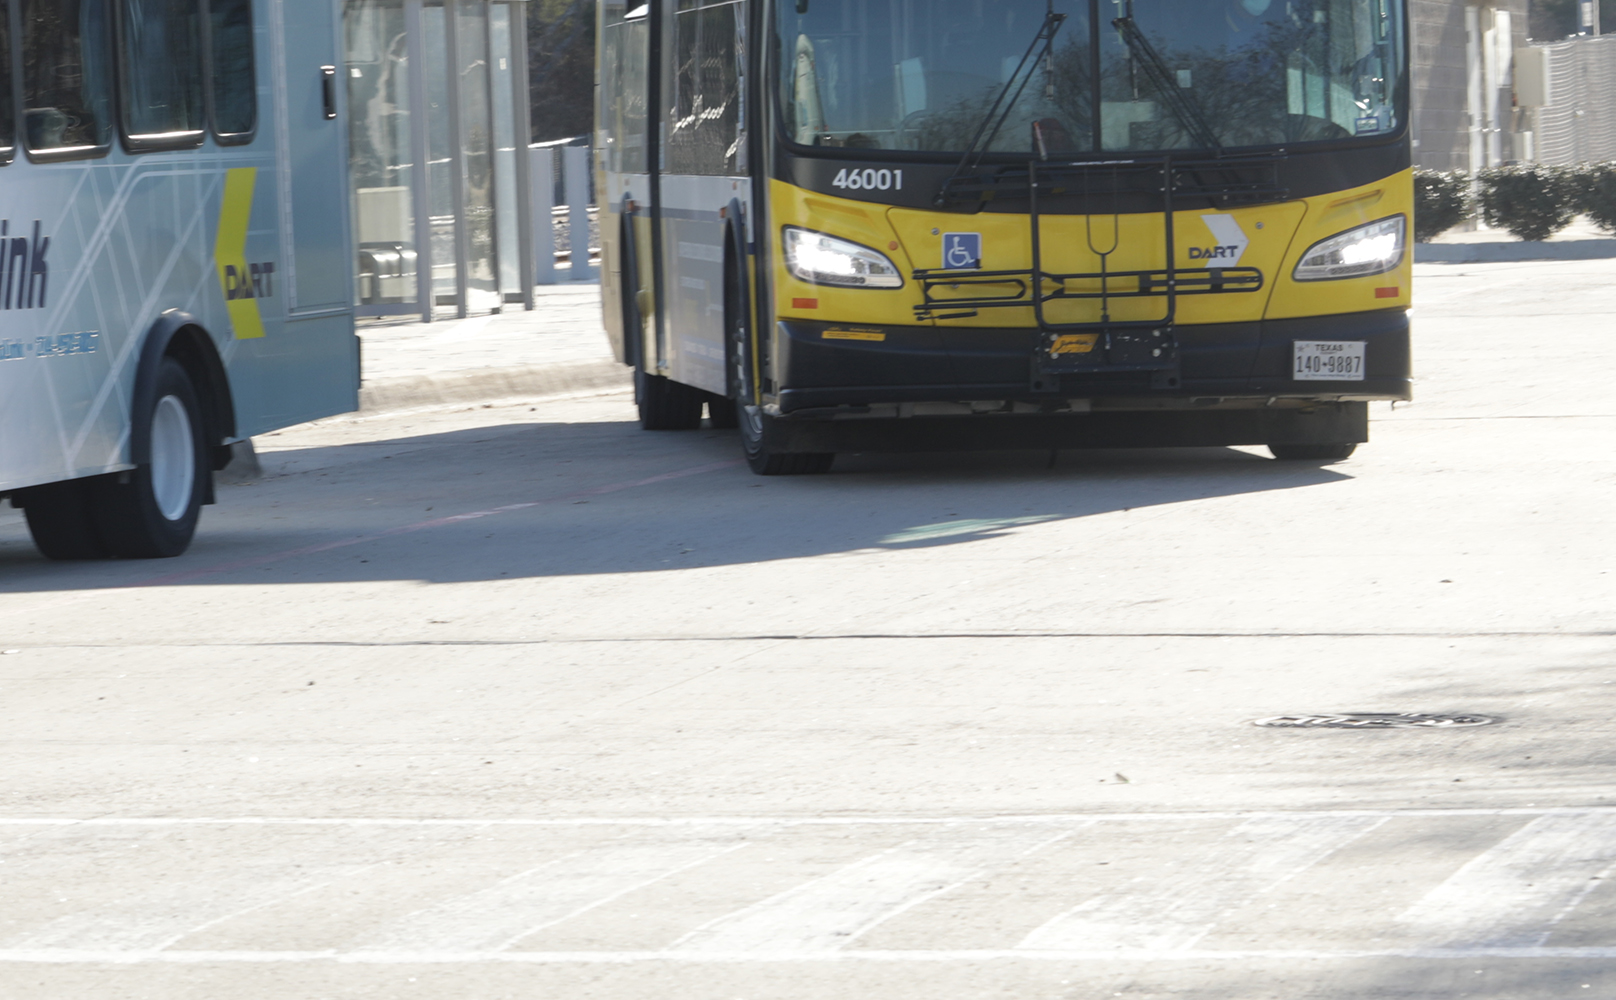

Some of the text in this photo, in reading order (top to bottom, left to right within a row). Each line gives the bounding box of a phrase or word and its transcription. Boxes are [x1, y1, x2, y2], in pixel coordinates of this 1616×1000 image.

[832, 168, 902, 190] 46001
[1188, 245, 1238, 259] DART
[225, 262, 274, 300] DART
[1314, 344, 1344, 352] TEXAS
